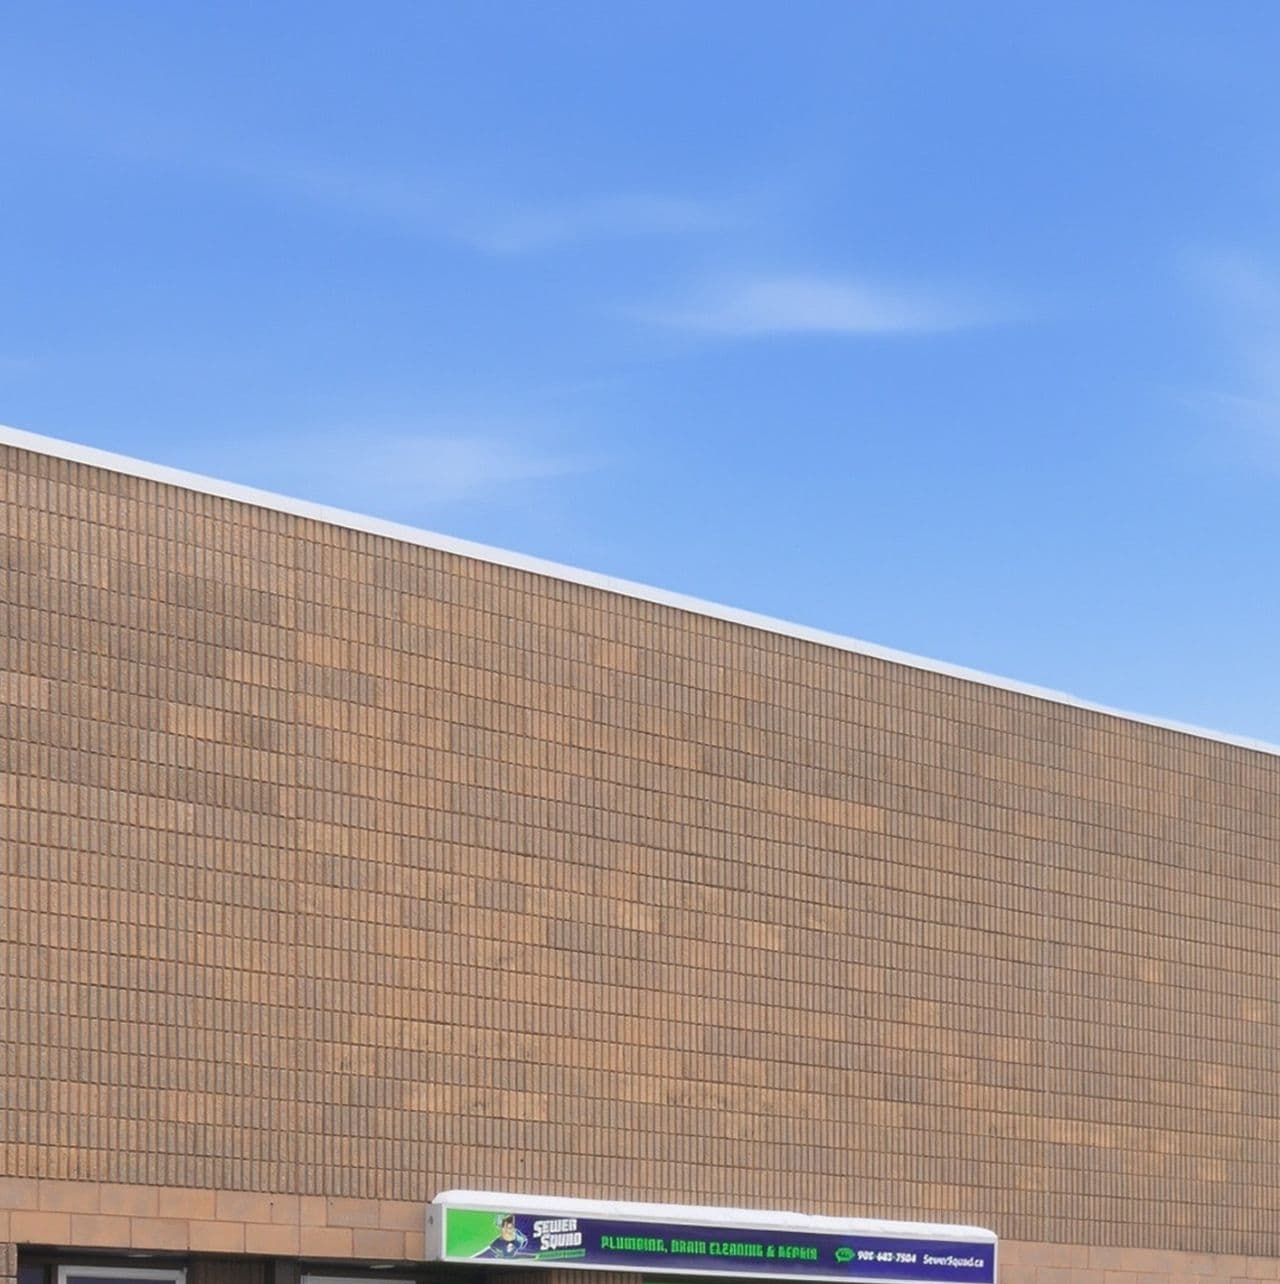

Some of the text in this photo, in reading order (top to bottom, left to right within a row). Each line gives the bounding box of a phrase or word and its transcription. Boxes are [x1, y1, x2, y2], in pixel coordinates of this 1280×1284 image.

[533, 1219, 577, 1238] SEWER
[540, 1232, 583, 1251] SQUAD
[671, 1239, 706, 1255] DRAIN
[709, 1242, 763, 1258] CLEANING
[778, 1245, 818, 1260] REPAIR
[923, 1254, 985, 1269] SewerSquad.ca
